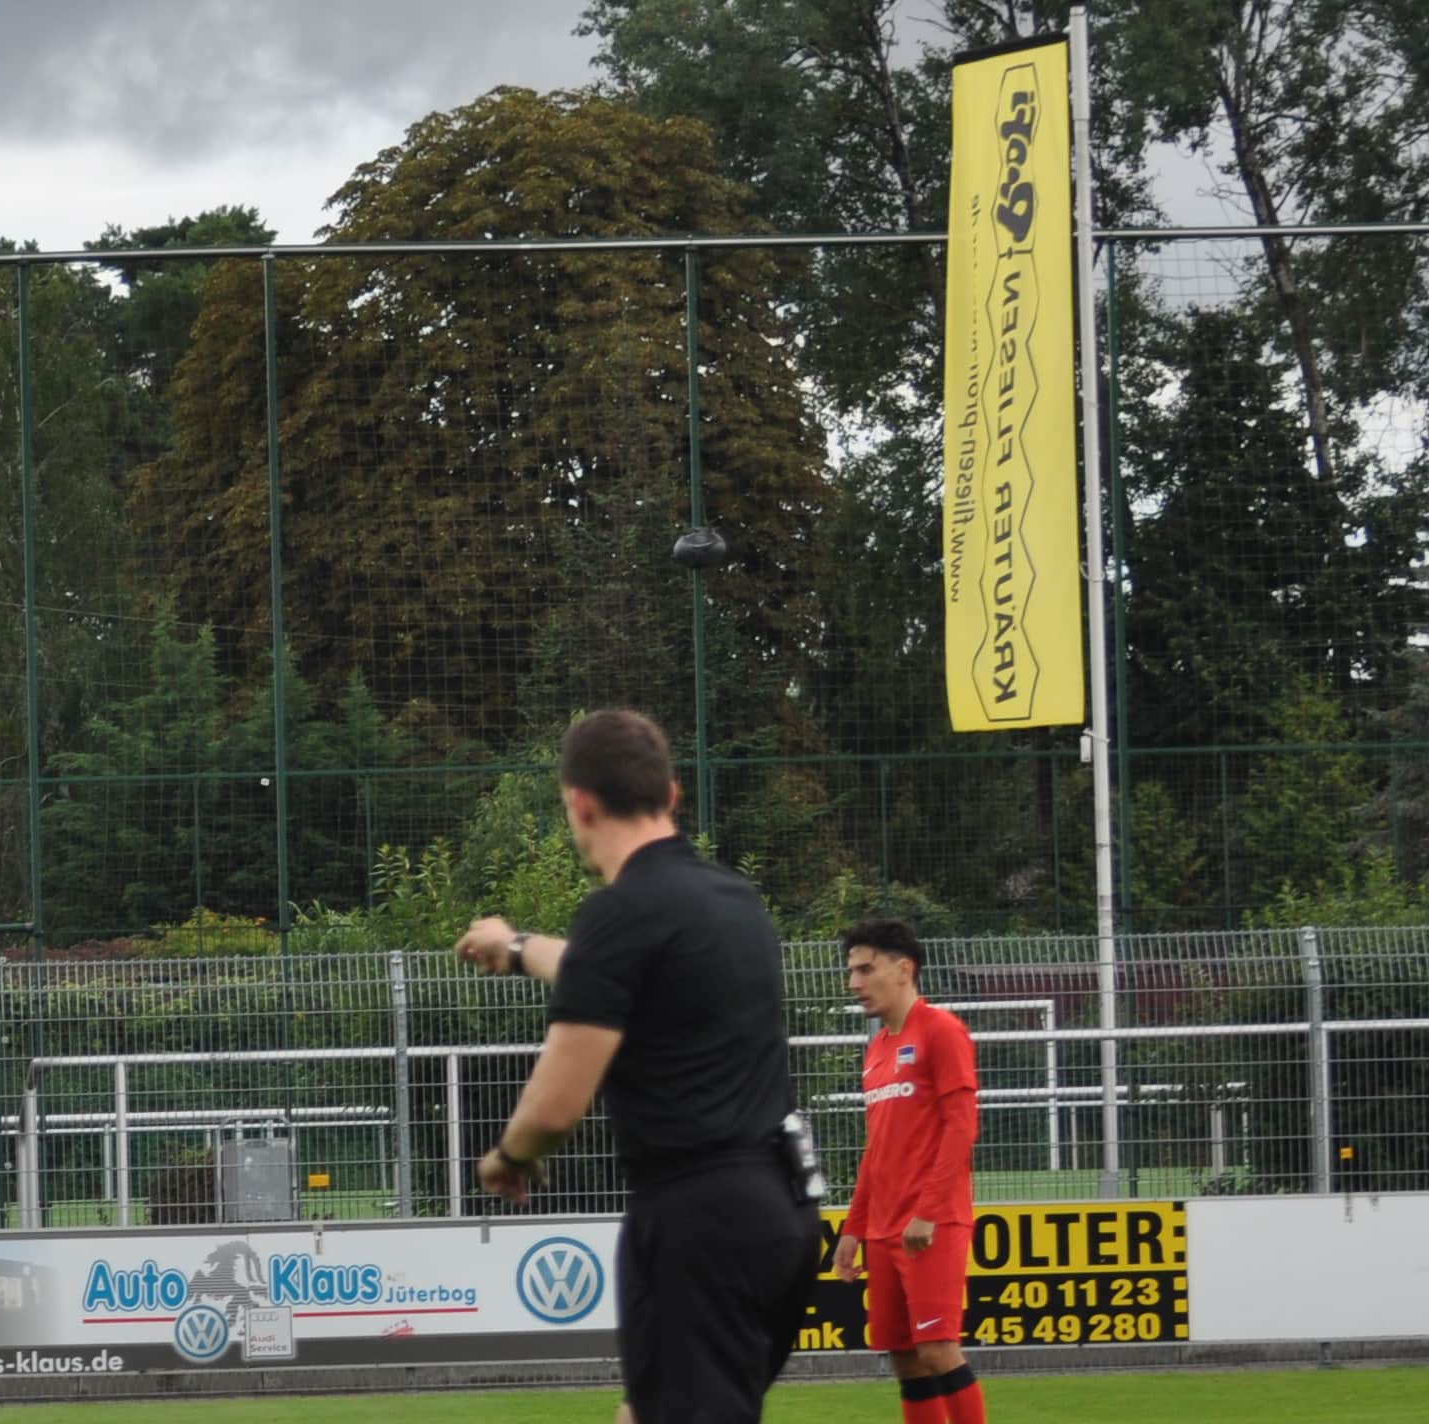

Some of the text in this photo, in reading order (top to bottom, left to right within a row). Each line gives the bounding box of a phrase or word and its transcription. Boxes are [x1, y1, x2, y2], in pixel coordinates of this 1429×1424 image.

[974, 1210, 1165, 1270] OLTER
[83, 1254, 477, 1310] Auto Klaus Jüterbog
[999, 1281, 1048, 1310] 40
[1057, 1279, 1097, 1307] 11
[1109, 1278, 1160, 1306] 23
[1032, 1315, 1081, 1342] 49
[1089, 1312, 1160, 1341] 280
